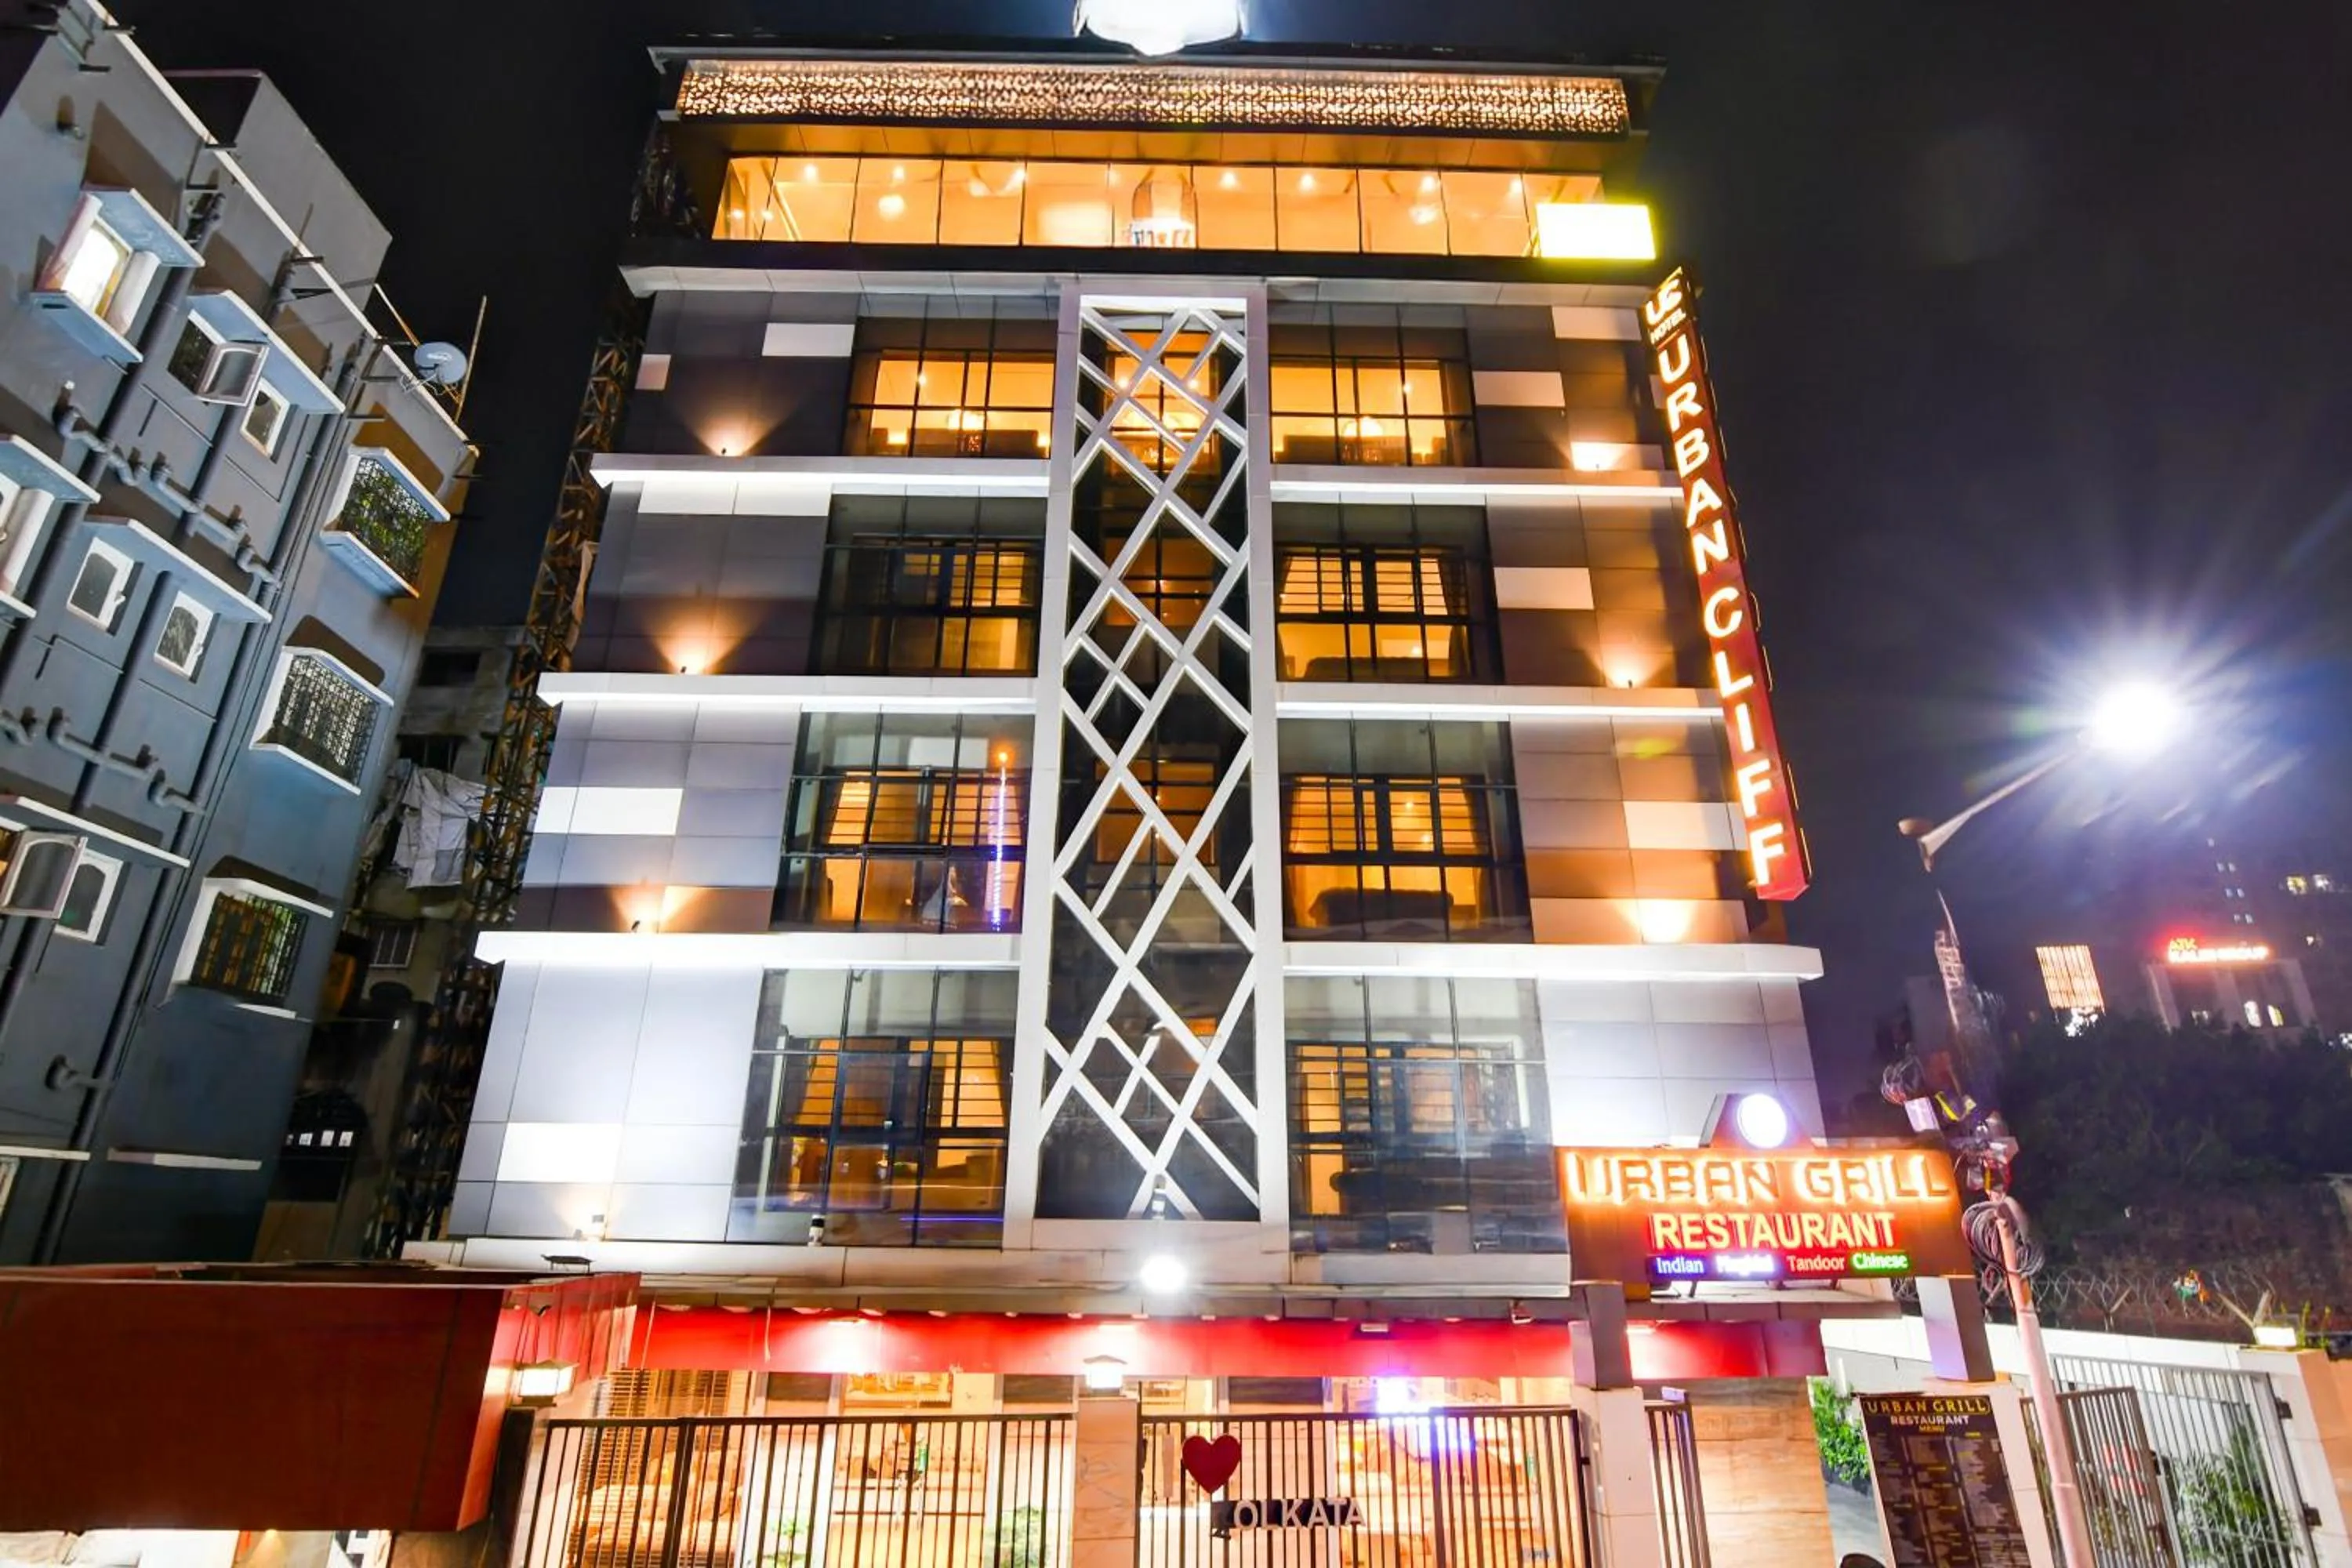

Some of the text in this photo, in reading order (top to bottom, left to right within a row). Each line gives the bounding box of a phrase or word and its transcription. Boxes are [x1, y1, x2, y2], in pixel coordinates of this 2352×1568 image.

[1650, 308, 1686, 345] HOTEL
[1570, 1152, 1950, 1205] URBAN GRILL
[1651, 1211, 1896, 1250] RESTAURANT
[1656, 1257, 1704, 1274] Indian
[1787, 1255, 1845, 1271] Tandoor
[1852, 1253, 1908, 1269] Chinese
[1867, 1397, 1987, 1414] URBAN GRILL
[1890, 1414, 1970, 1425] RESTAURANT
[1212, 1497, 1367, 1530] OLKATA
